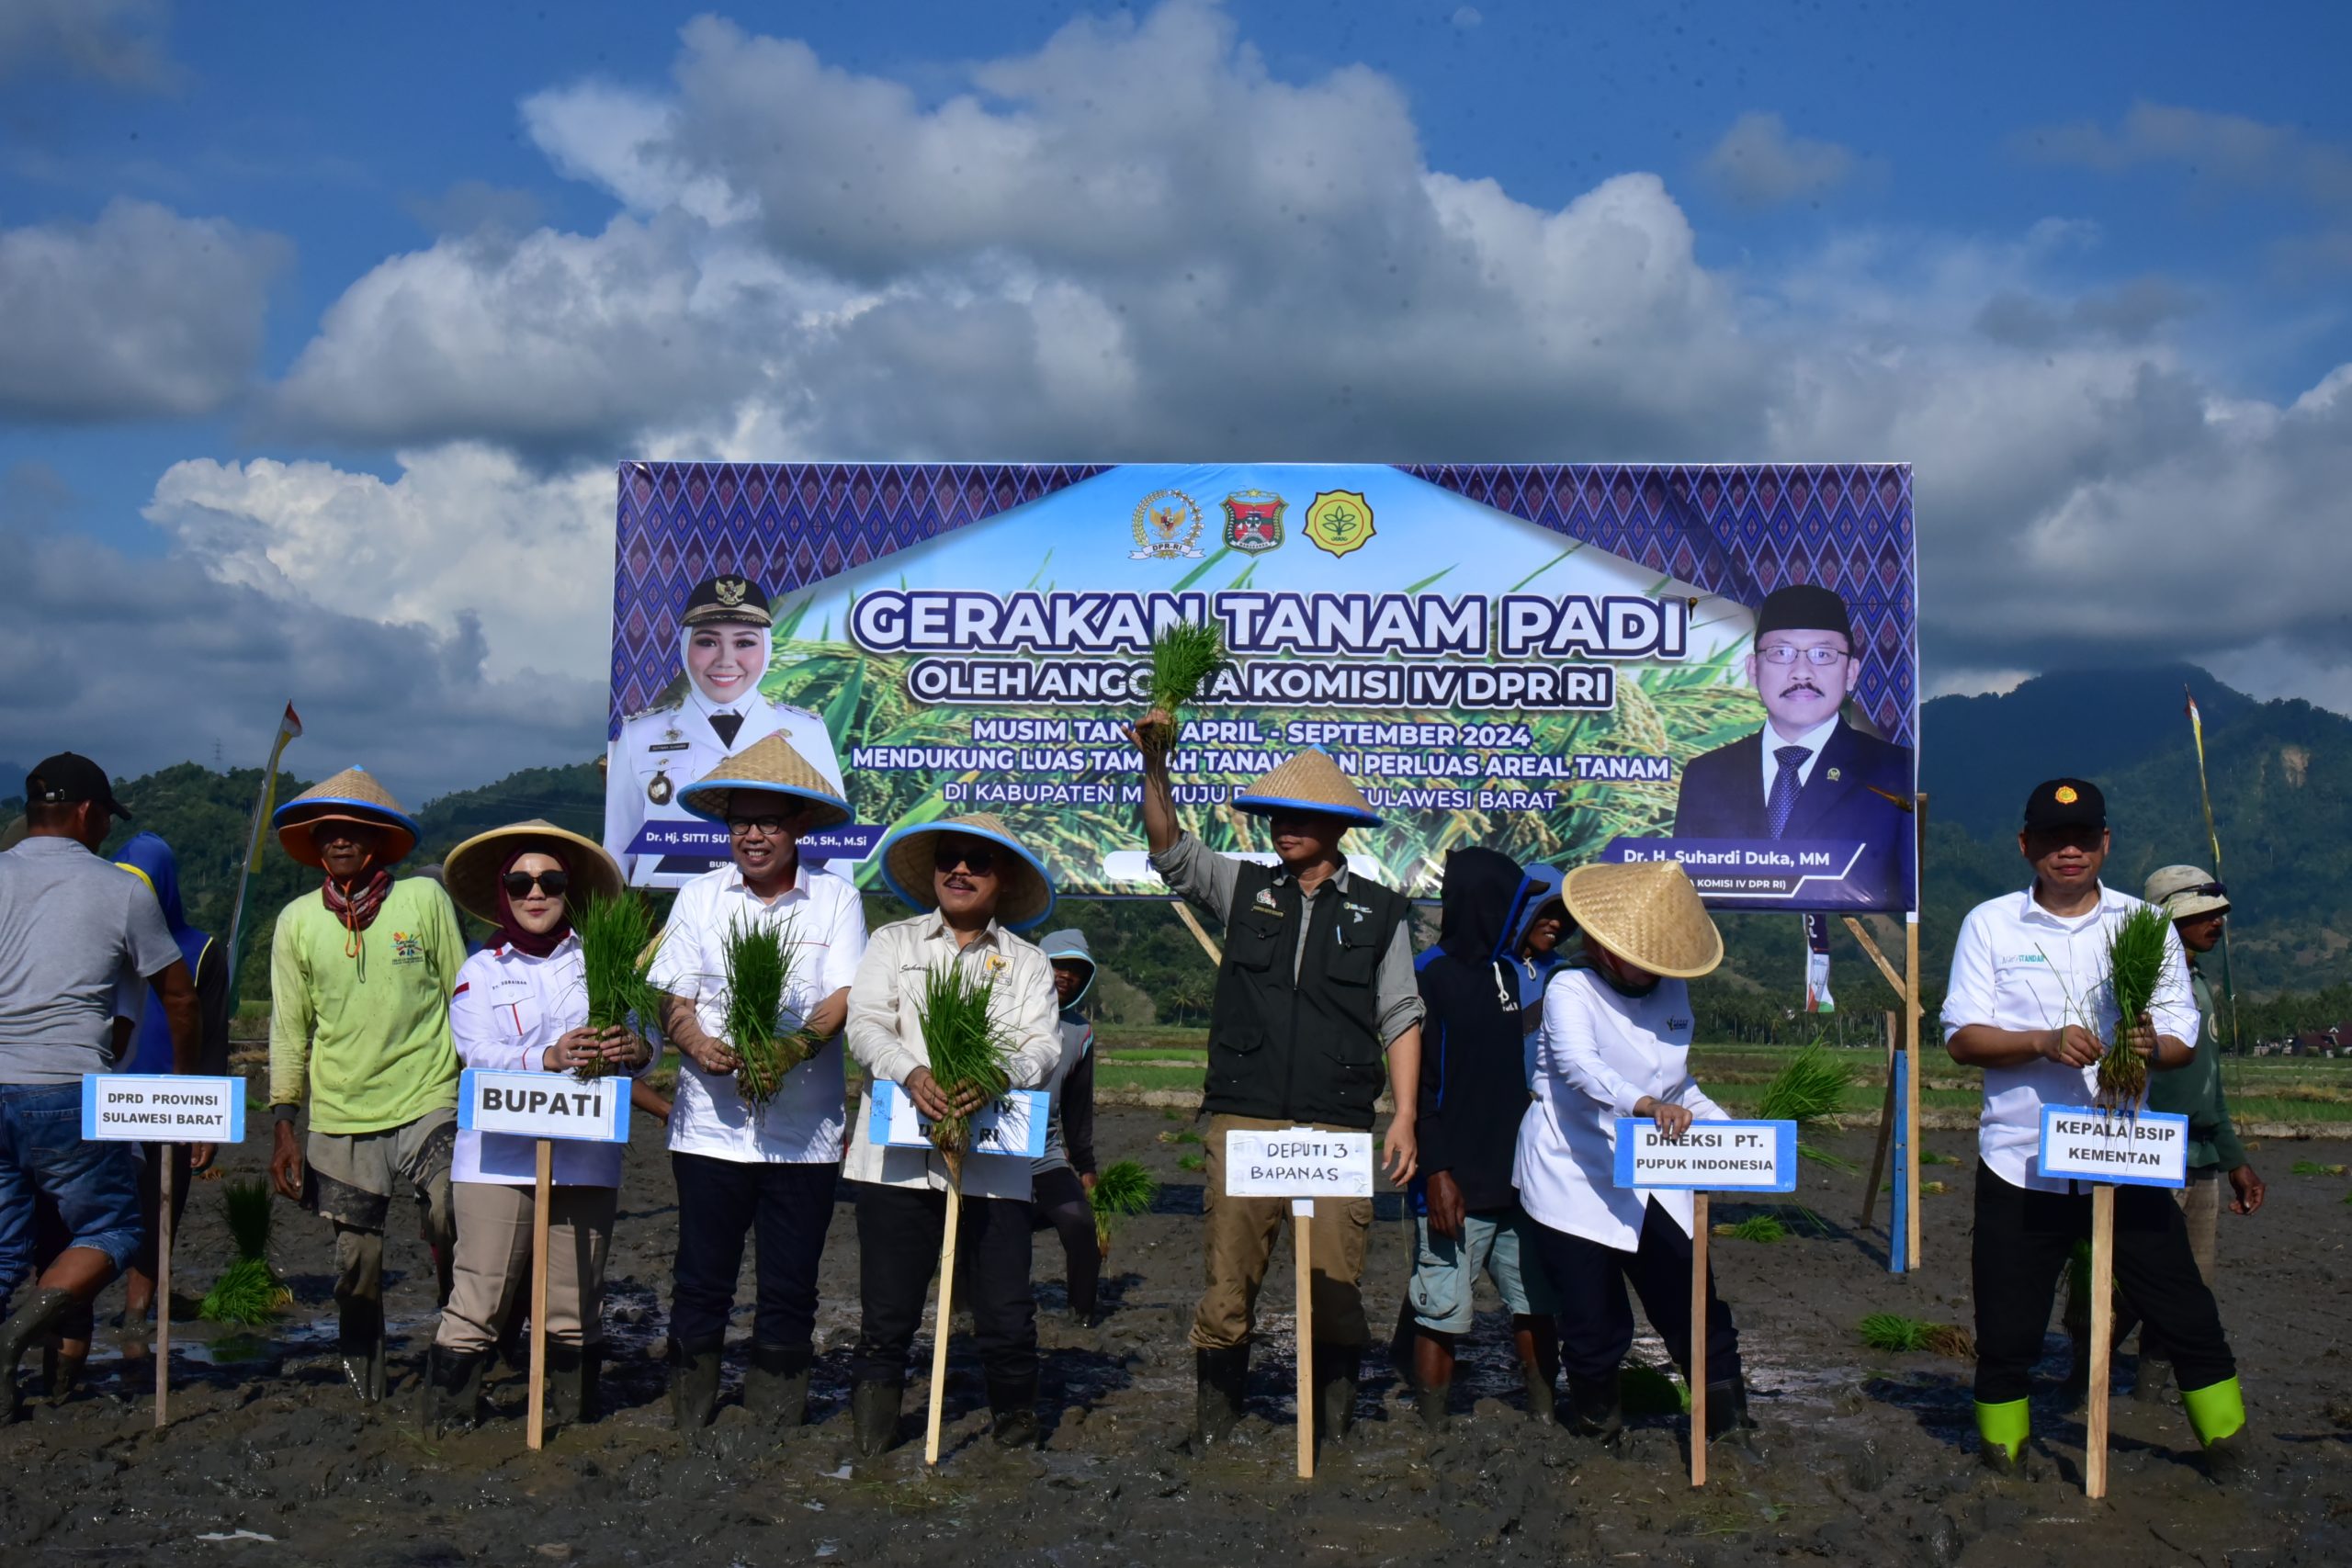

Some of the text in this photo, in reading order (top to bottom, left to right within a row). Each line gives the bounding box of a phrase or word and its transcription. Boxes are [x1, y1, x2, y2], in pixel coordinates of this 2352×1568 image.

[856, 592, 1683, 653] GERAKAN TANAM PADI
[917, 664, 1607, 704] OLEH ANGGA KOMISI IV DPR RI
[974, 719, 1066, 745] MUSIM
[1072, 721, 1129, 745] TAN
[1180, 722, 1263, 745] APRIL
[1288, 720, 1455, 750] SEPTEMBER
[1461, 726, 1531, 750] 2024
[853, 746, 1015, 773] MENDUKUNG
[1021, 747, 1084, 771] LUAS
[1090, 749, 1200, 773] TAMAH
[1364, 754, 1479, 780] PERLUAS
[1485, 756, 1570, 777] AREAL
[1576, 754, 1668, 782] TANAM
[945, 784, 967, 800] DI
[976, 782, 1114, 805] KABUPATEN
[1122, 785, 1226, 804] MUJU
[1359, 788, 1472, 809] ULAWESI
[1480, 791, 1557, 813] BARAT
[645, 832, 663, 842] Dr.
[664, 832, 681, 846] Hj.
[682, 833, 709, 844] SITTI
[843, 837, 867, 846] M.Si
[1623, 849, 1829, 868] Dr. H. Suhardi Duka, MM
[1697, 879, 1734, 888] KOMISI
[1736, 880, 1747, 888] IV
[1748, 880, 1770, 888] DPR
[1772, 880, 1786, 890] RI)
[107, 1092, 218, 1106] DPRD PROVINSI
[482, 1088, 602, 1118] BUPATI
[102, 1111, 223, 1125] SULAWESI BARAT
[978, 1127, 1000, 1143] RI
[1645, 1132, 1764, 1148] DIREKSI PT.
[2055, 1120, 2177, 1143] KEPALA BSIP
[1267, 1142, 1349, 1158] DEPUTI 3
[2067, 1146, 2162, 1167] KEMENTAN
[1636, 1158, 1773, 1170] PUPUK INDONESIA
